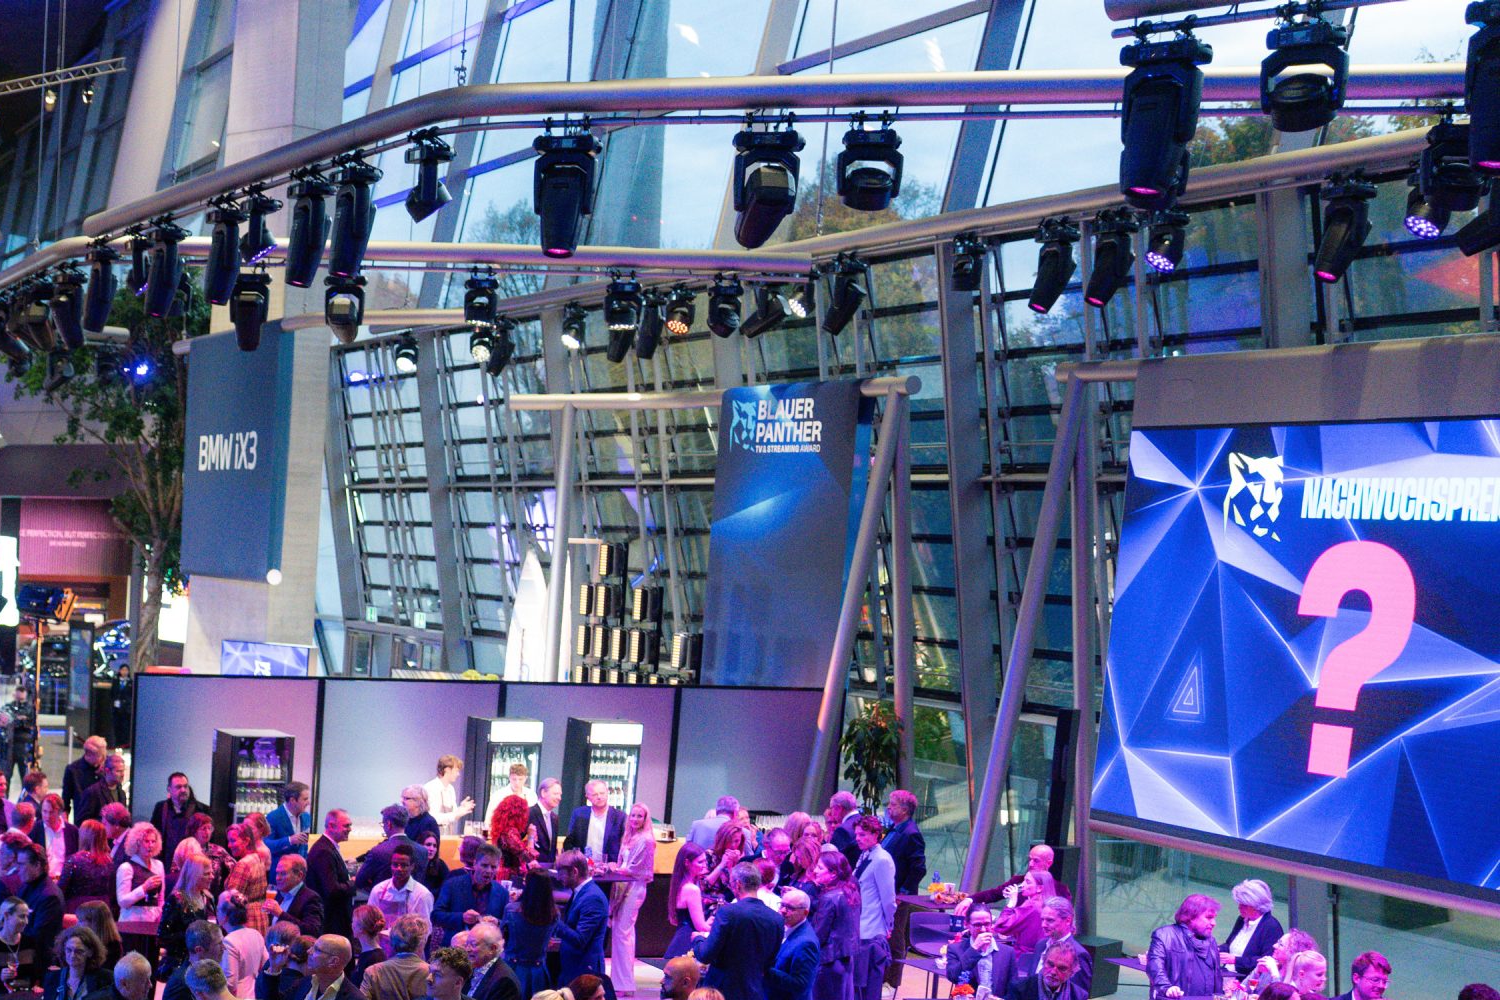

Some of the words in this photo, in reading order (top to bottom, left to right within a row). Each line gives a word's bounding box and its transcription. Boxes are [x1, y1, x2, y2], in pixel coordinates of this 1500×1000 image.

[757, 398, 815, 421] BLAUER
[755, 420, 823, 443] PANTHER
[198, 433, 233, 471] BMW
[234, 431, 258, 470] iX3
[767, 444, 799, 453] STREAMING
[799, 444, 821, 452] AWARD
[1300, 477, 1500, 522] NACHWUCHSPREI
[1297, 540, 1416, 779] ?
